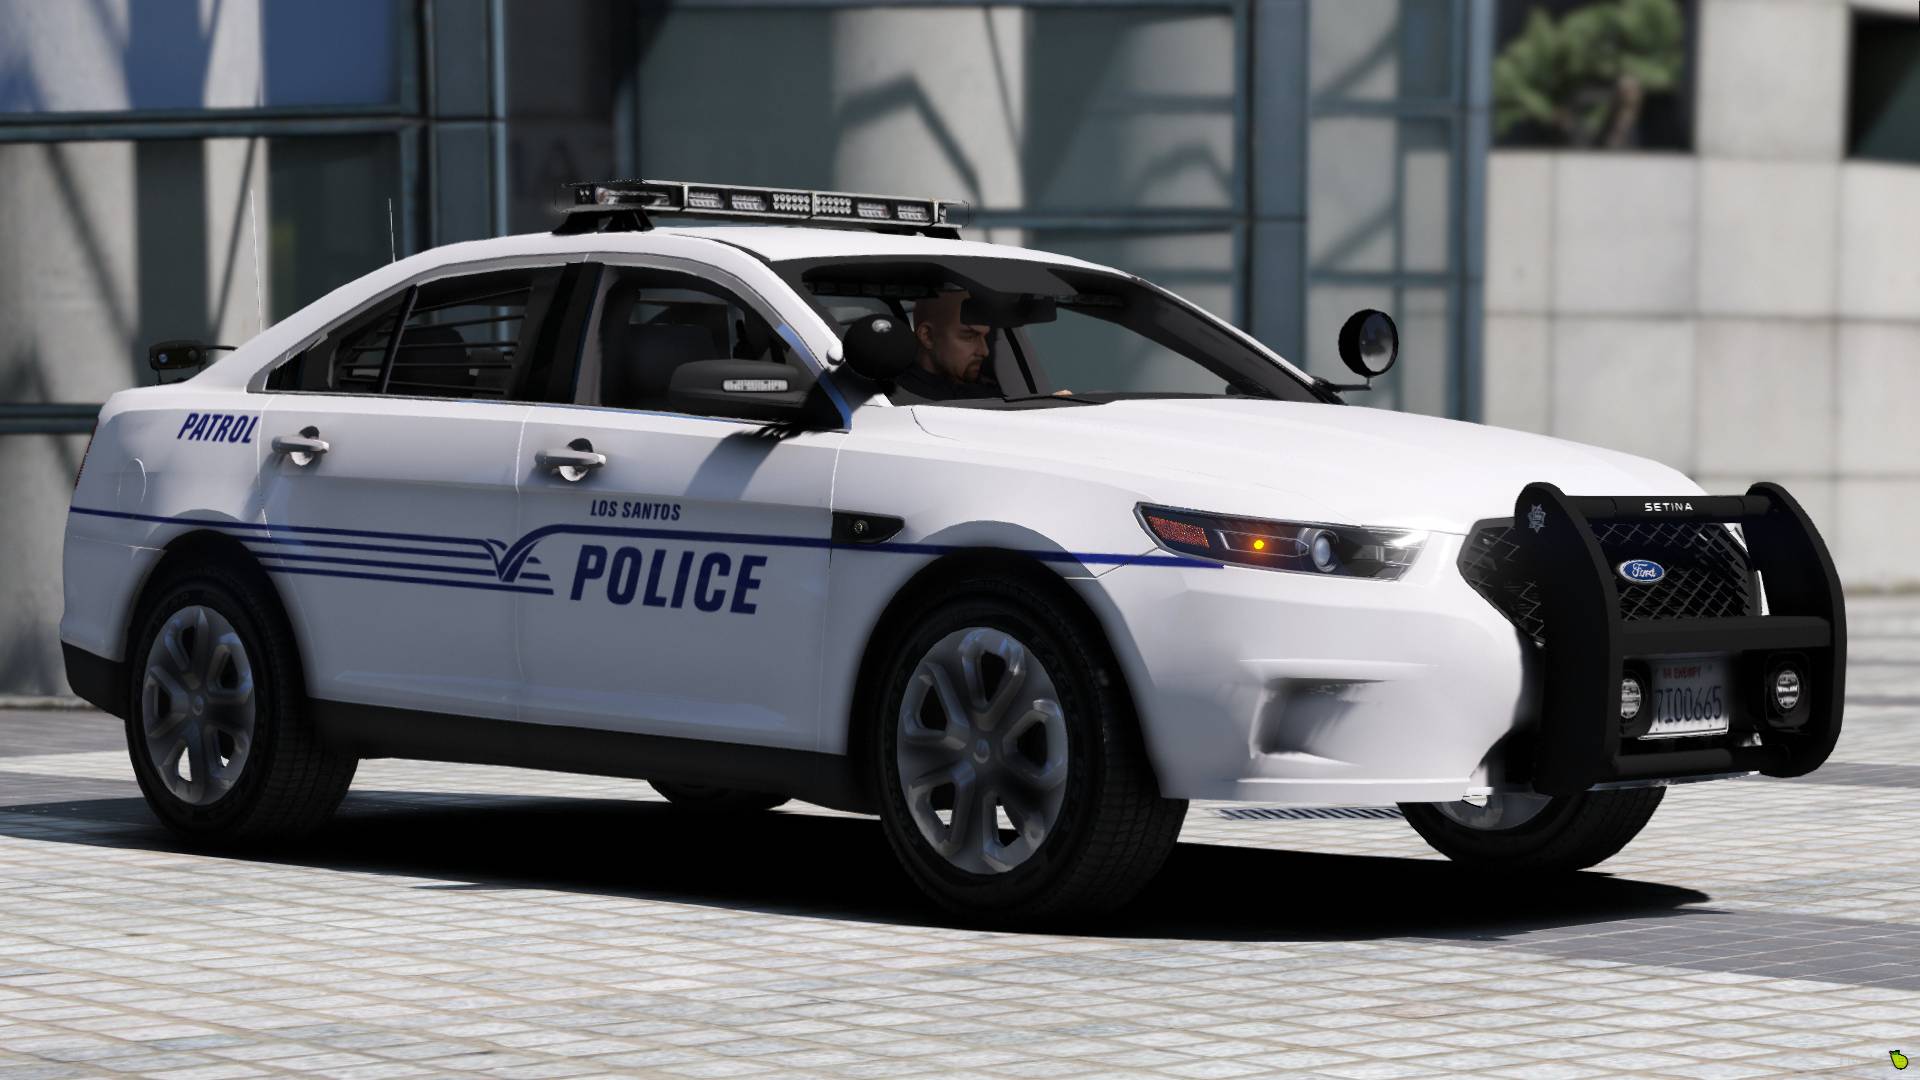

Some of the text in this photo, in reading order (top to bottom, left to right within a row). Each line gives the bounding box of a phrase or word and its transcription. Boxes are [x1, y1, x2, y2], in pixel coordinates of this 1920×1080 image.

[177, 413, 259, 444] PATROL
[590, 500, 681, 521] LOS SANTOS
[1644, 502, 1694, 512] SETINA
[570, 544, 768, 615] POLICE
